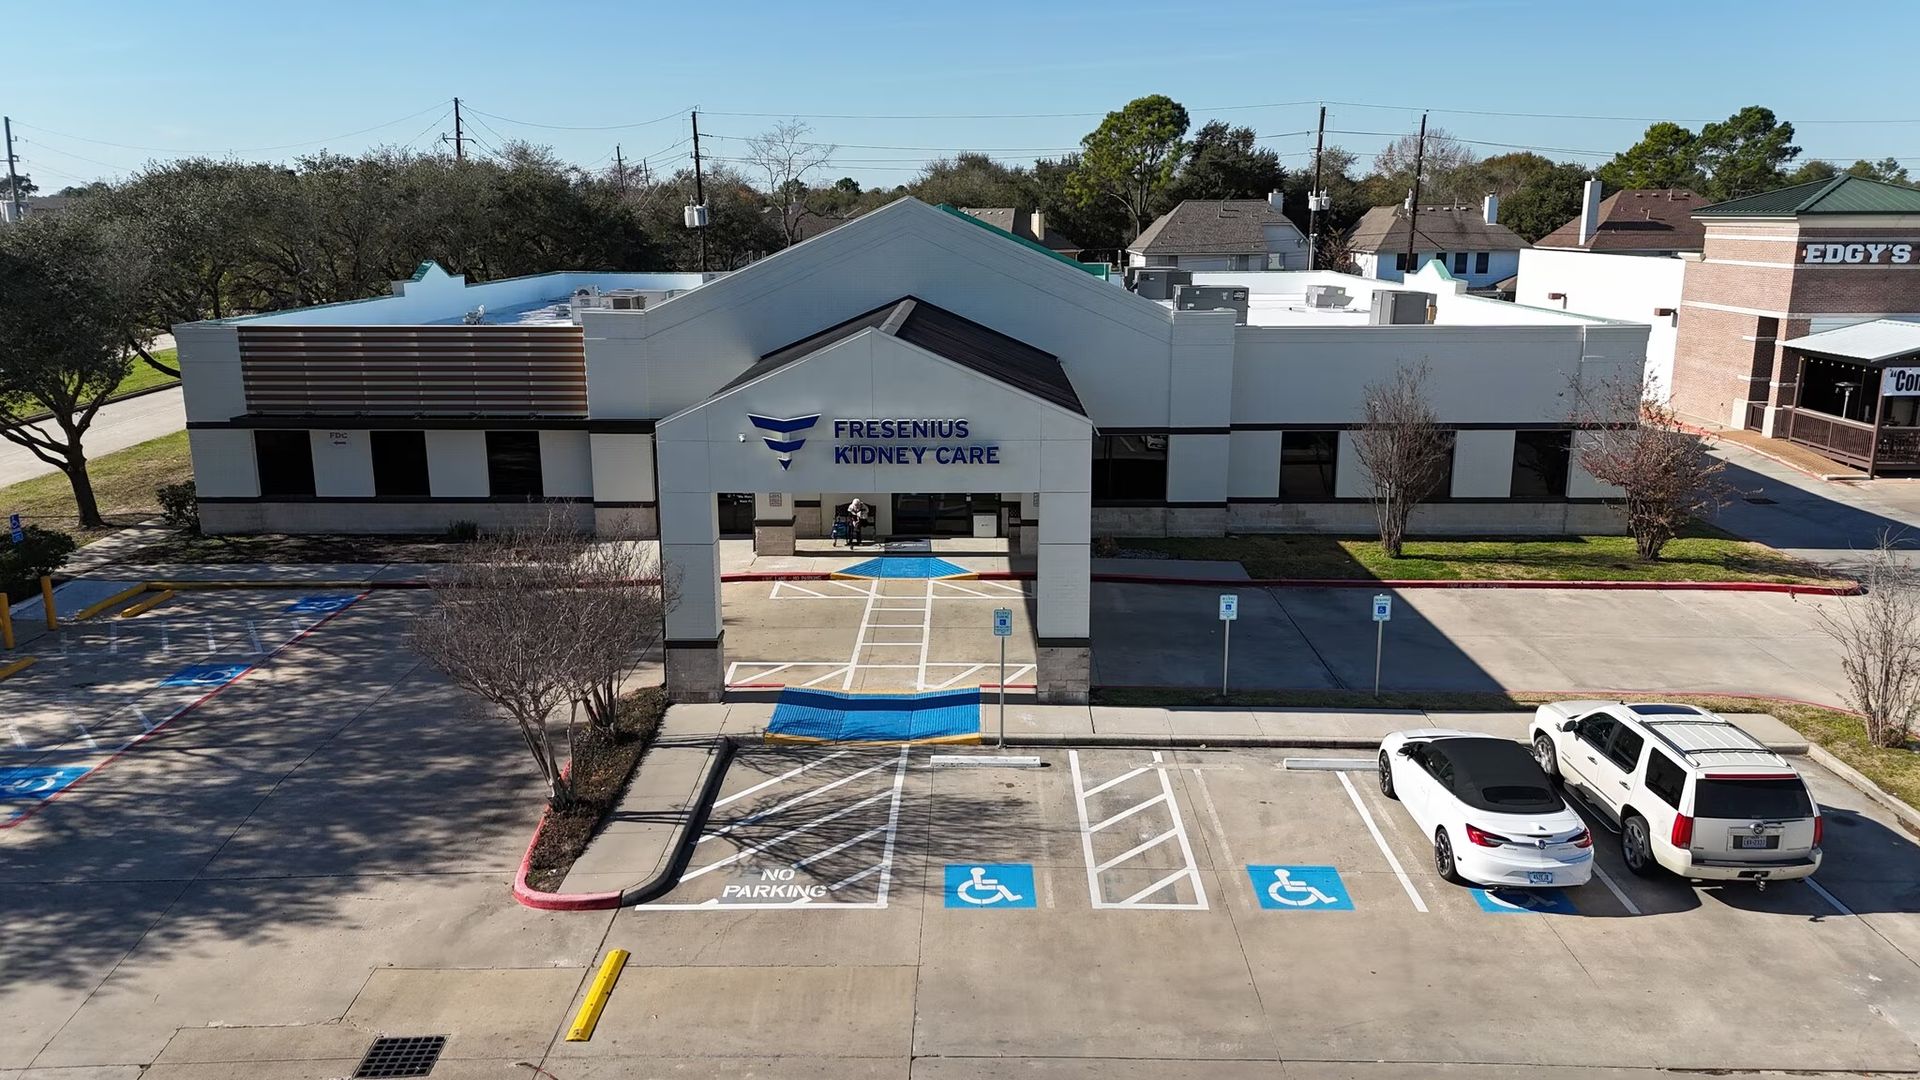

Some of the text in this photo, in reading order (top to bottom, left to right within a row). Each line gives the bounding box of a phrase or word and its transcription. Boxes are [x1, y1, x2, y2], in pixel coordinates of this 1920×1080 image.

[1804, 244, 1912, 263] EDGY'S
[834, 419, 969, 438] FRESENIUS
[834, 446, 1000, 465] KIDNEY CARE
[760, 868, 795, 881] NO
[722, 884, 827, 898] PARKING
